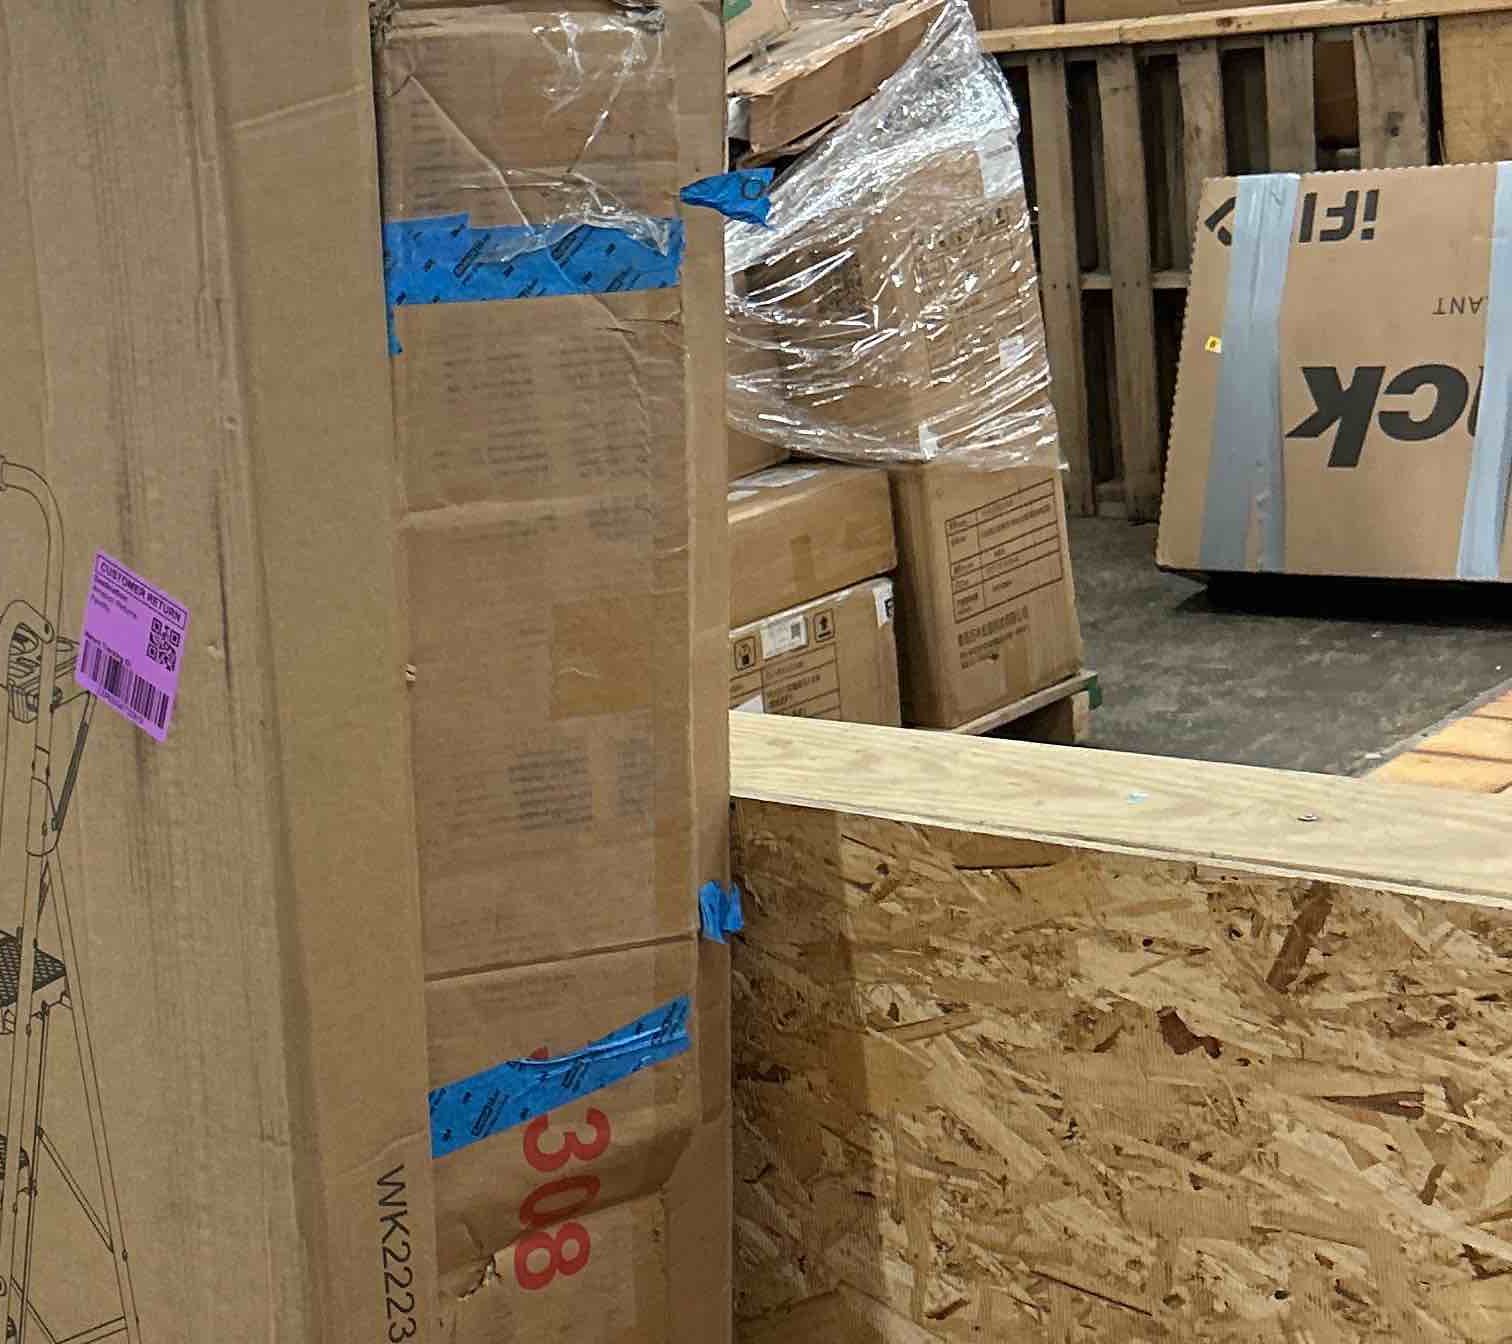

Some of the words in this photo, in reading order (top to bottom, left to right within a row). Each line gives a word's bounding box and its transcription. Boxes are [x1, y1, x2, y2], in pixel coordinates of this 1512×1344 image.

[1431, 295, 1487, 317] ANT
[1284, 363, 1484, 469] ck
[99, 560, 147, 600] CUSTOMER
[145, 592, 183, 623] RETURN
